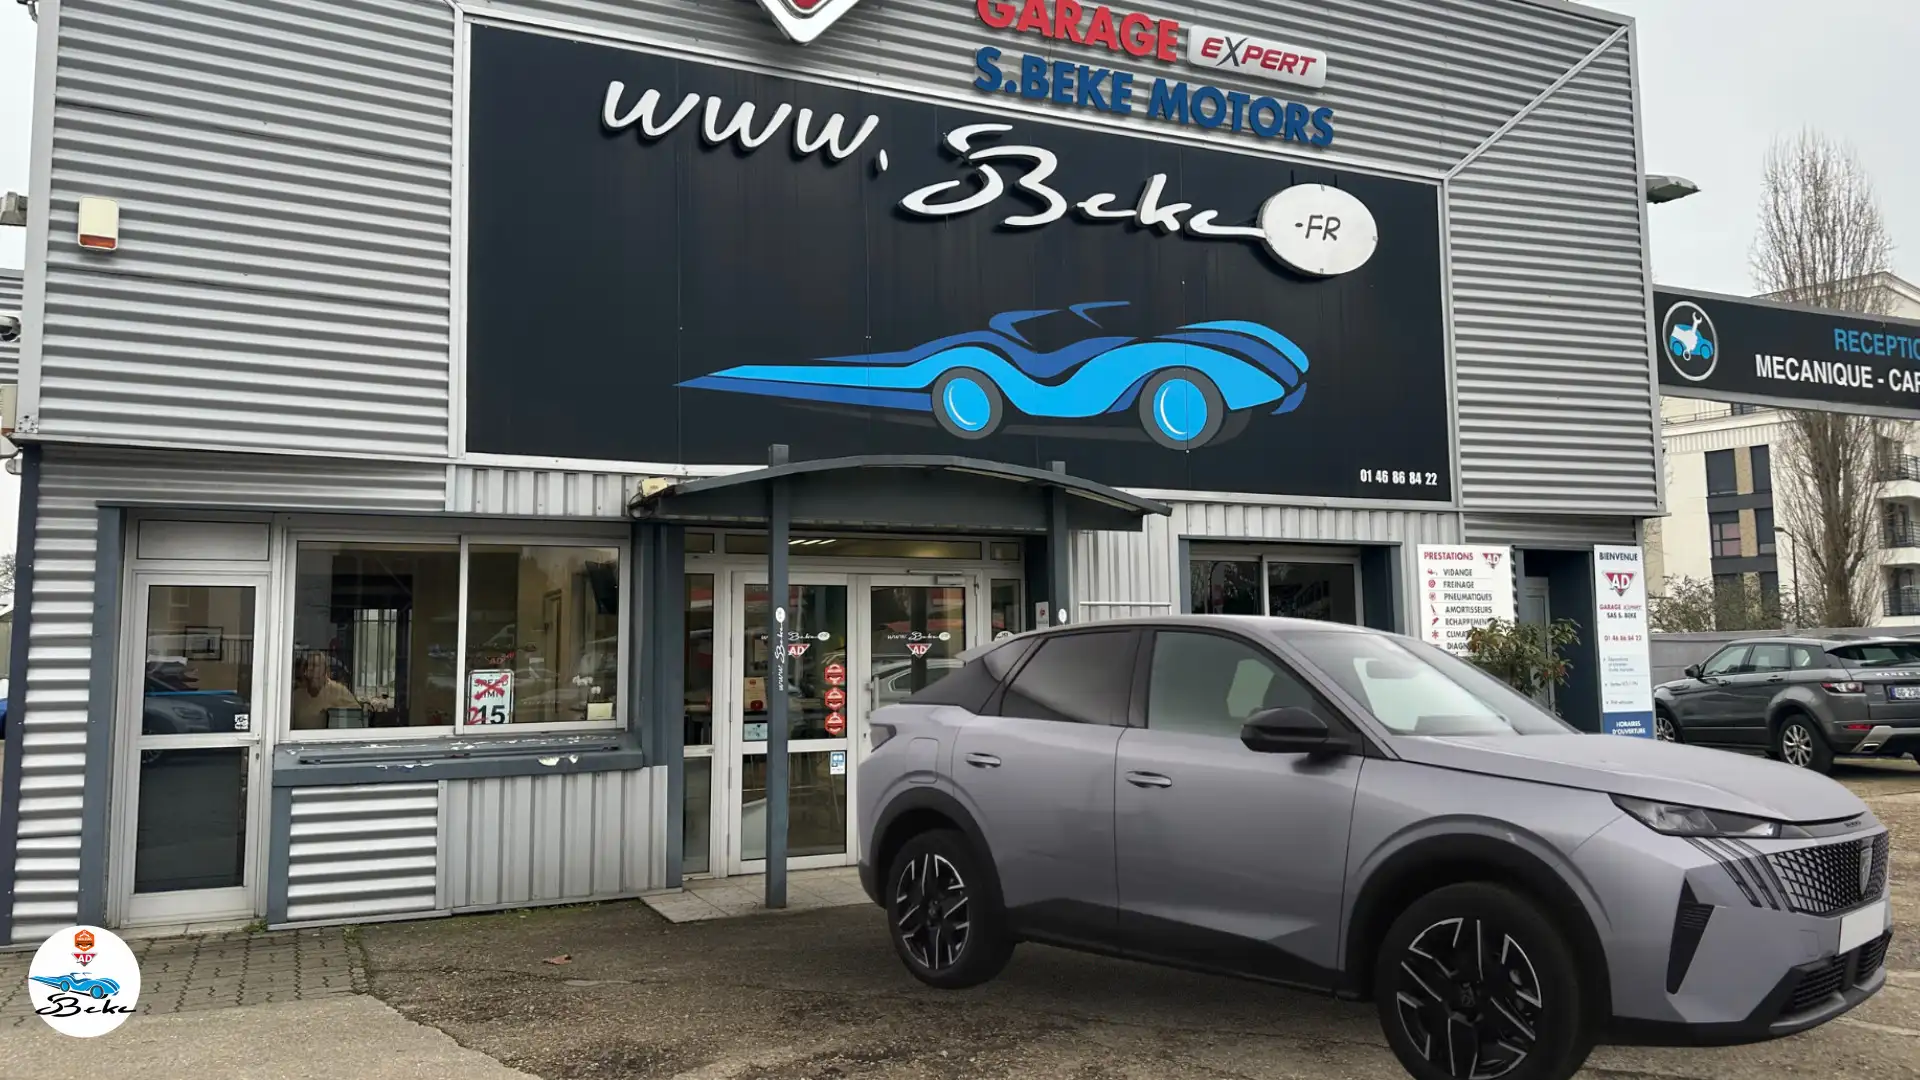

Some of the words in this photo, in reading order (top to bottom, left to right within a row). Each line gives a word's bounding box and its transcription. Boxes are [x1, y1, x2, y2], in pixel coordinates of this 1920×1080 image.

[976, 0, 1180, 63] GARAGE
[1201, 36, 1317, 77] EXPERT
[974, 46, 1134, 115] S.BEKE
[1147, 78, 1334, 147] MOTORS
[602, 80, 889, 172] www.
[1755, 354, 1874, 389] MECANIQUE
[1360, 469, 1372, 482] 01
[1375, 470, 1389, 484] 46
[1392, 470, 1406, 484] 86
[1409, 471, 1422, 485] 84
[1425, 472, 1438, 486] 22
[1424, 551, 1474, 561] PRESTATIONS
[1599, 552, 1638, 561] BIENVENUE
[1443, 568, 1473, 577] VIDANGE
[1443, 580, 1475, 589] FREINAGE
[1611, 573, 1630, 590] AD
[1444, 592, 1493, 601] PNEUMATIQUES
[1445, 605, 1493, 614] AMORTISSEURS
[1445, 617, 1488, 626] ECHAPPEMEN
[788, 646, 805, 655] AD
[911, 645, 927, 654] AD
